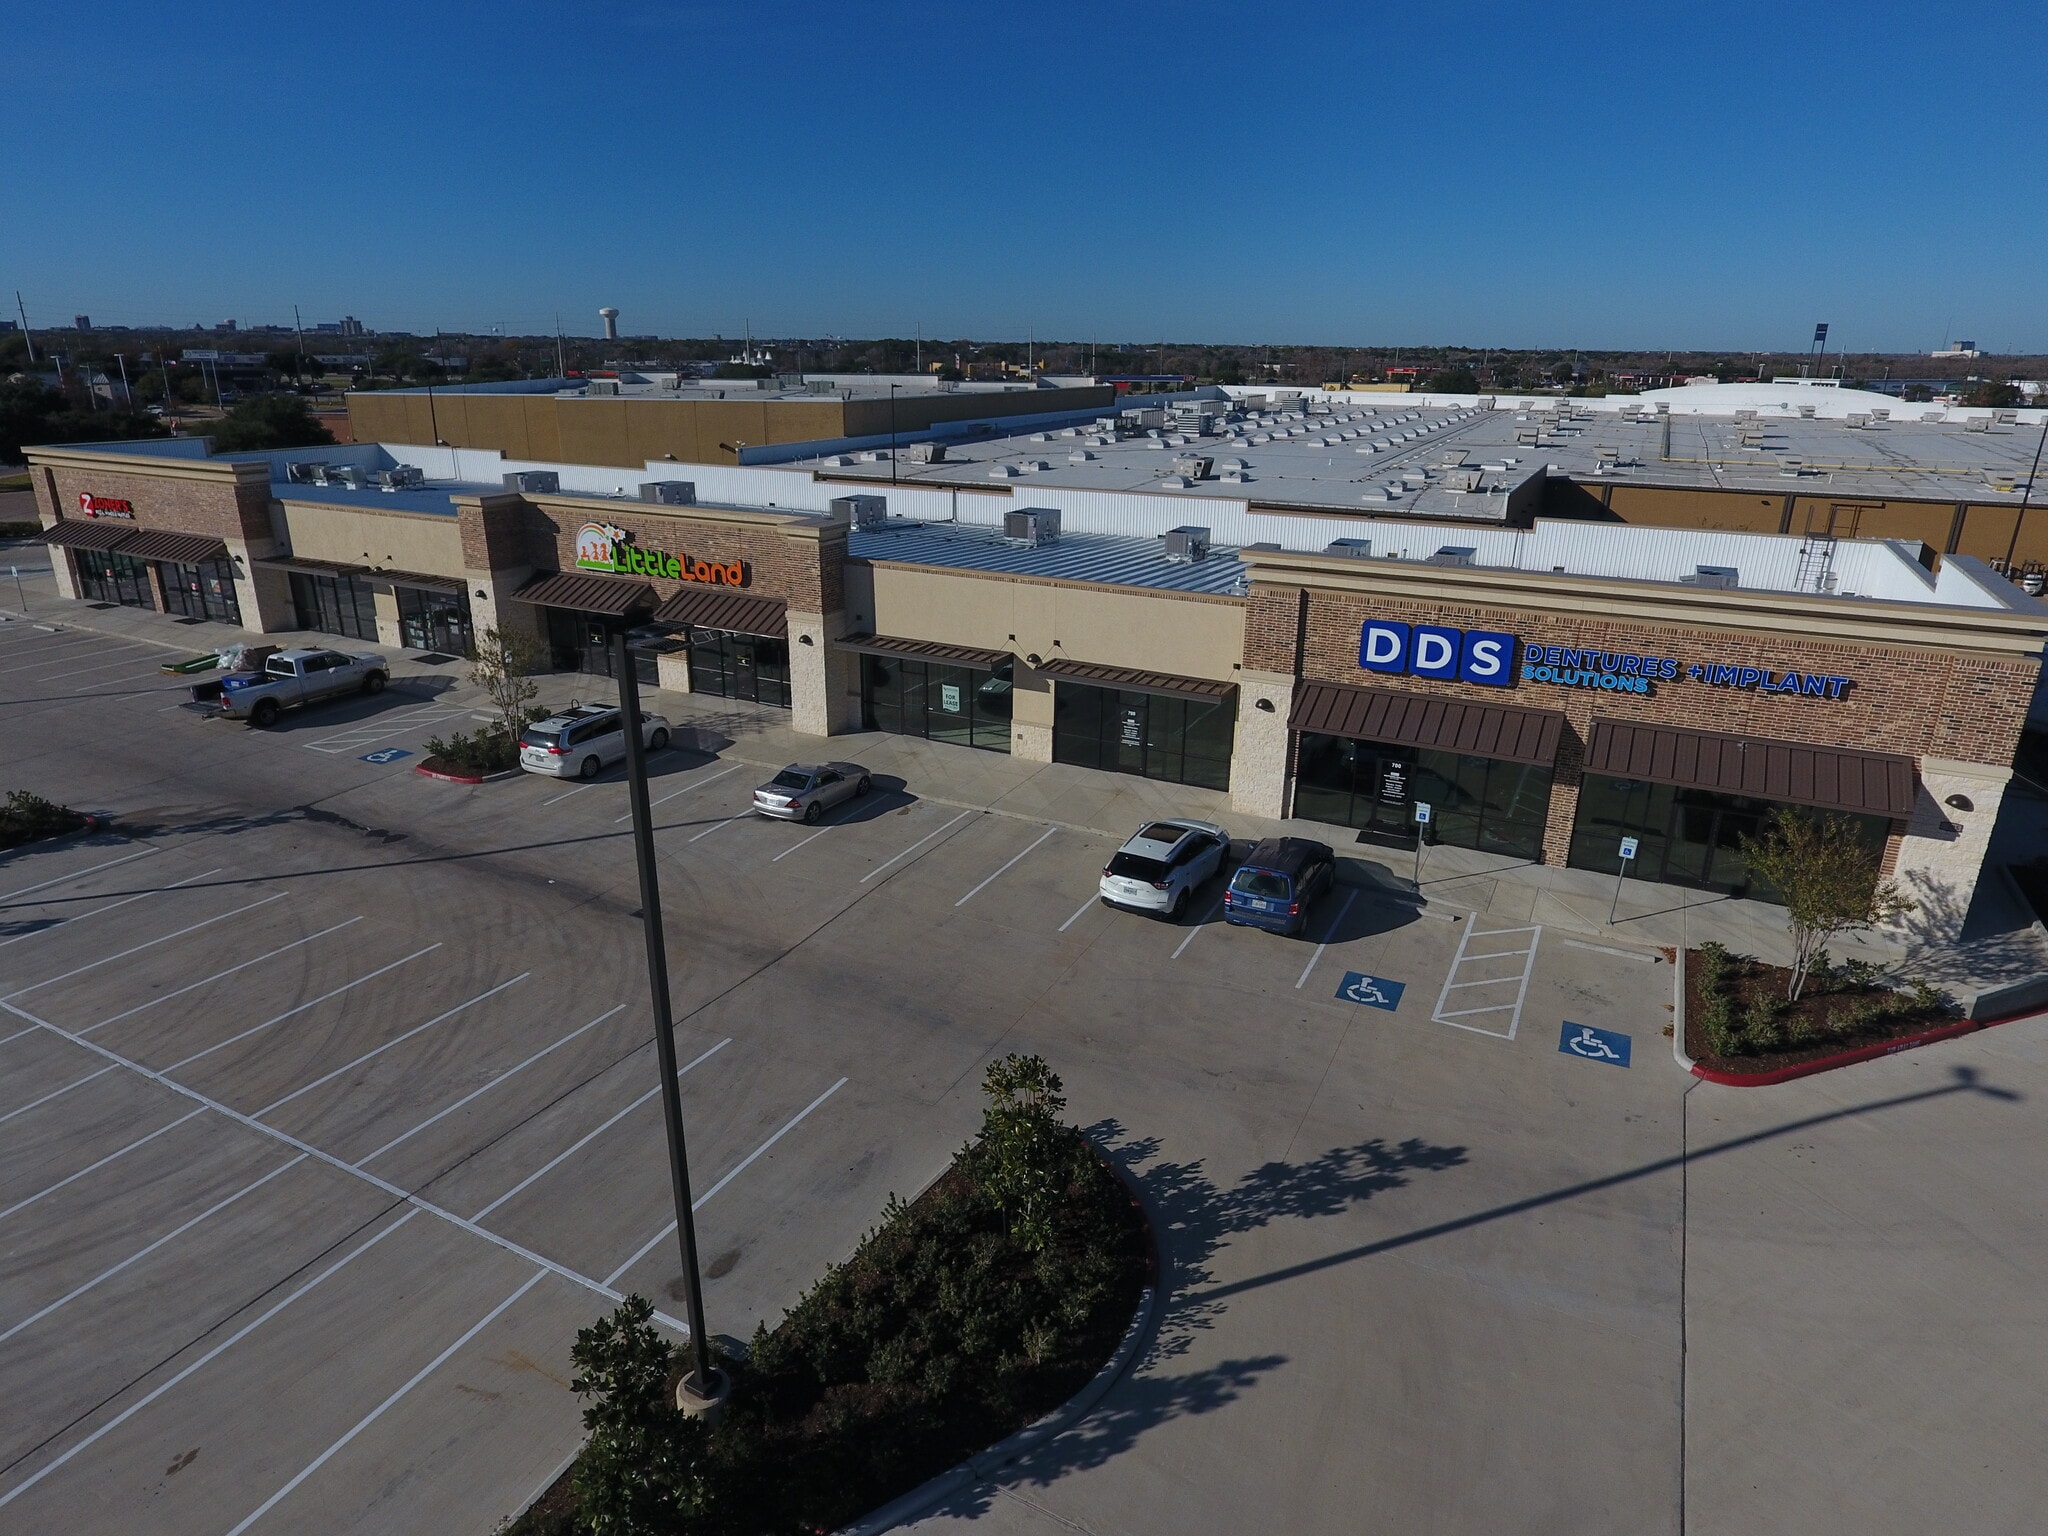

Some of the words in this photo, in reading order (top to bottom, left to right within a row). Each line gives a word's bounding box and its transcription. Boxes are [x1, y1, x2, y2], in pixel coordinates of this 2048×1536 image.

[93, 498, 129, 513] ZONER'S
[1365, 627, 1503, 676] DDS
[1524, 644, 1678, 679] DENTURES
[1521, 664, 1649, 694] SOLUTIONS
[944, 699, 958, 707] LEASE
